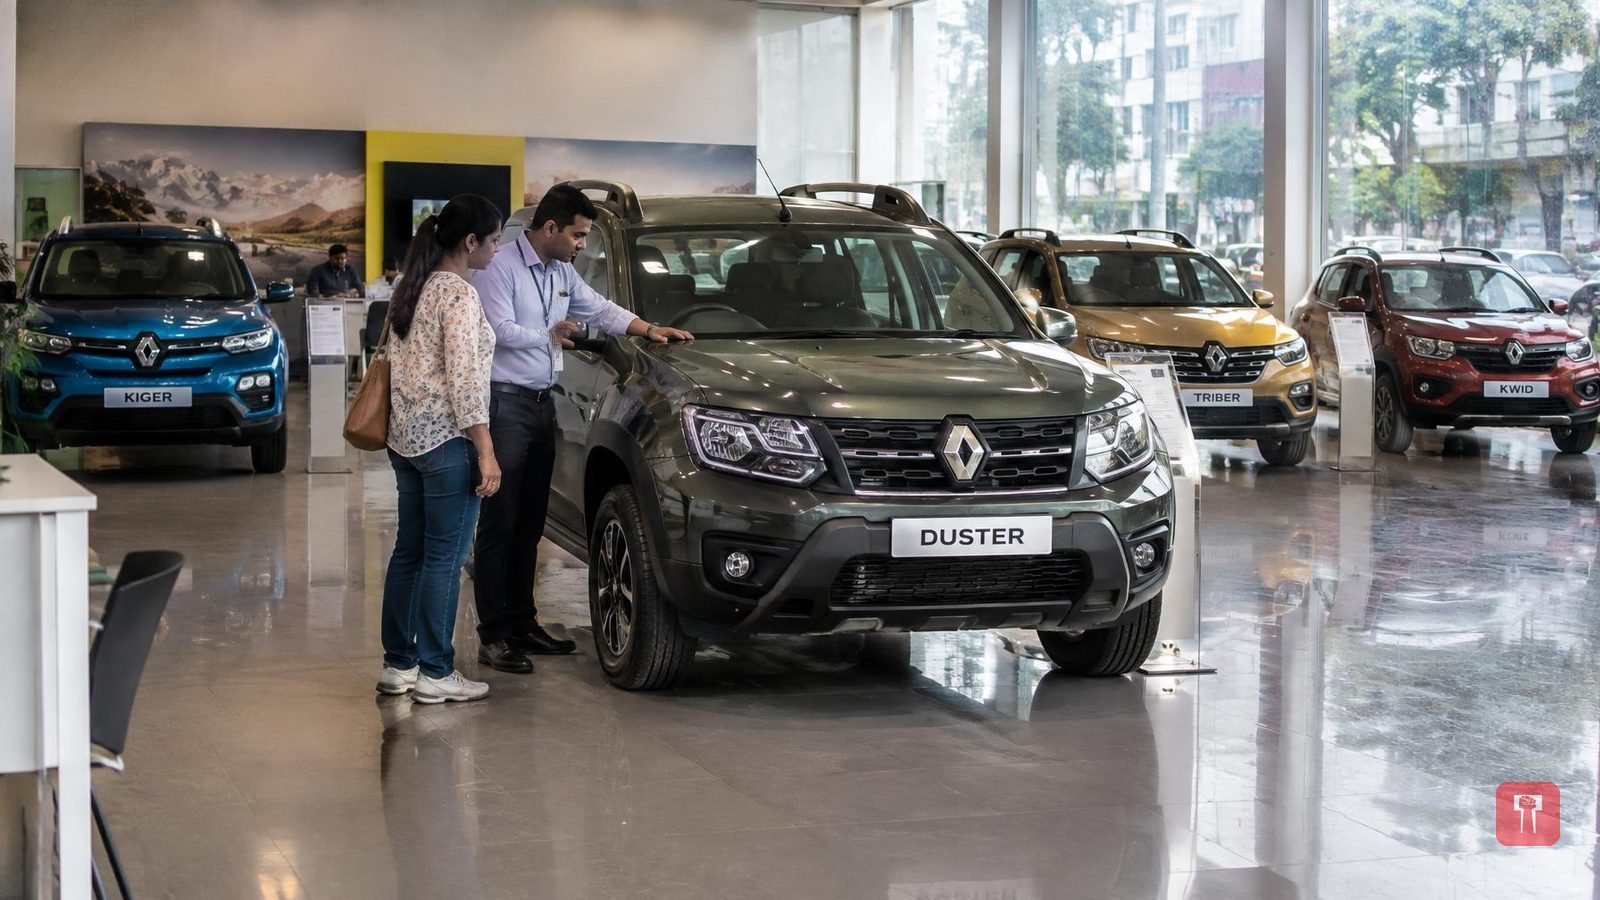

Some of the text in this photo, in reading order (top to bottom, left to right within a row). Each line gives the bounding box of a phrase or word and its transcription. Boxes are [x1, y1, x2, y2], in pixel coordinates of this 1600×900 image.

[1500, 384, 1534, 394] KWID
[124, 392, 172, 403] KIGER
[1194, 393, 1240, 403] TRIBER
[920, 528, 1025, 546] DUSTER
